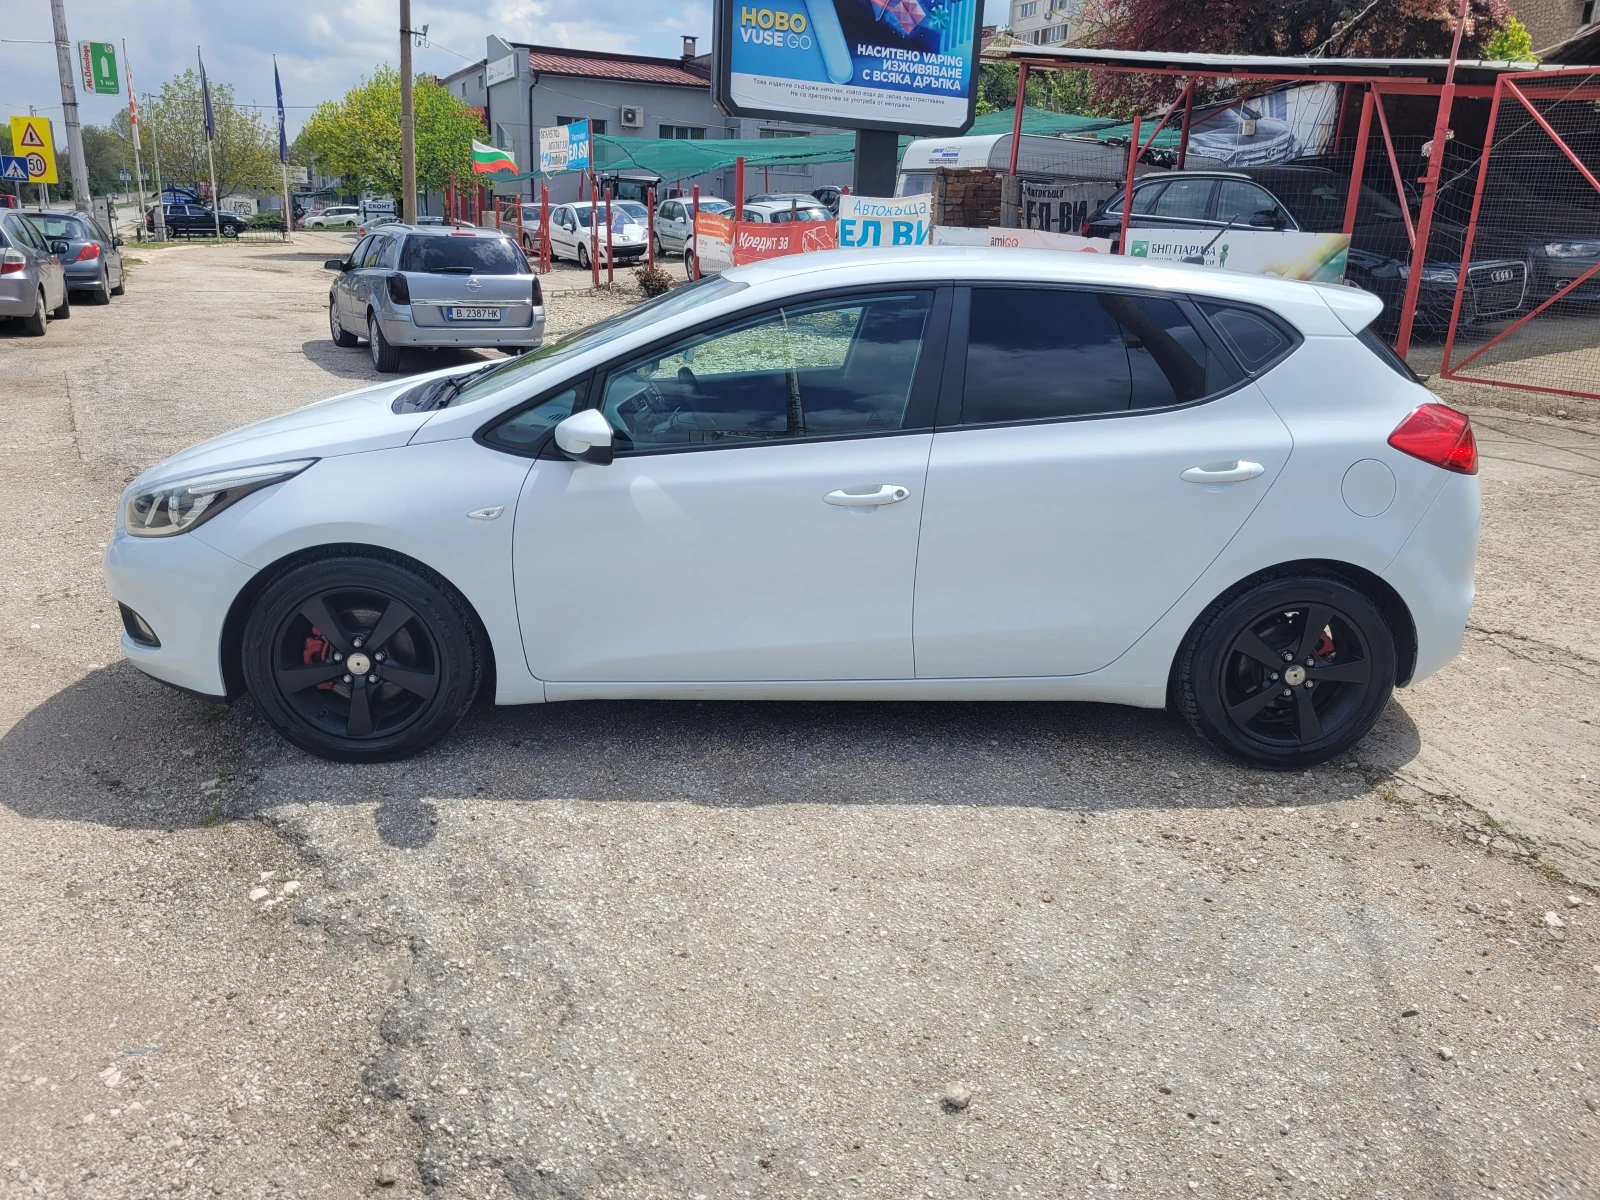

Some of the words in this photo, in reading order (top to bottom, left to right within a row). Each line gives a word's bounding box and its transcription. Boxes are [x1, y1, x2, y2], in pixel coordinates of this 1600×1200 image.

[741, 6, 807, 33] НОВО
[740, 27, 784, 47] VUSE
[787, 34, 812, 50] GO
[857, 44, 921, 61] НАСИТЕНО
[922, 52, 963, 67] VAPING
[862, 69, 871, 80] С
[873, 70, 911, 85] ВСЯКА
[913, 76, 961, 90] ДРЪПКА
[882, 60, 963, 79] ИЗЖИВЯВАНЕ
[769, 80, 792, 88] изделие
[28, 158, 42, 171] 50
[854, 200, 927, 217] Автокъща
[739, 232, 777, 252] Кредит
[778, 236, 789, 250] за
[841, 219, 881, 247] ЕЛ
[1151, 243, 1172, 254] БНП
